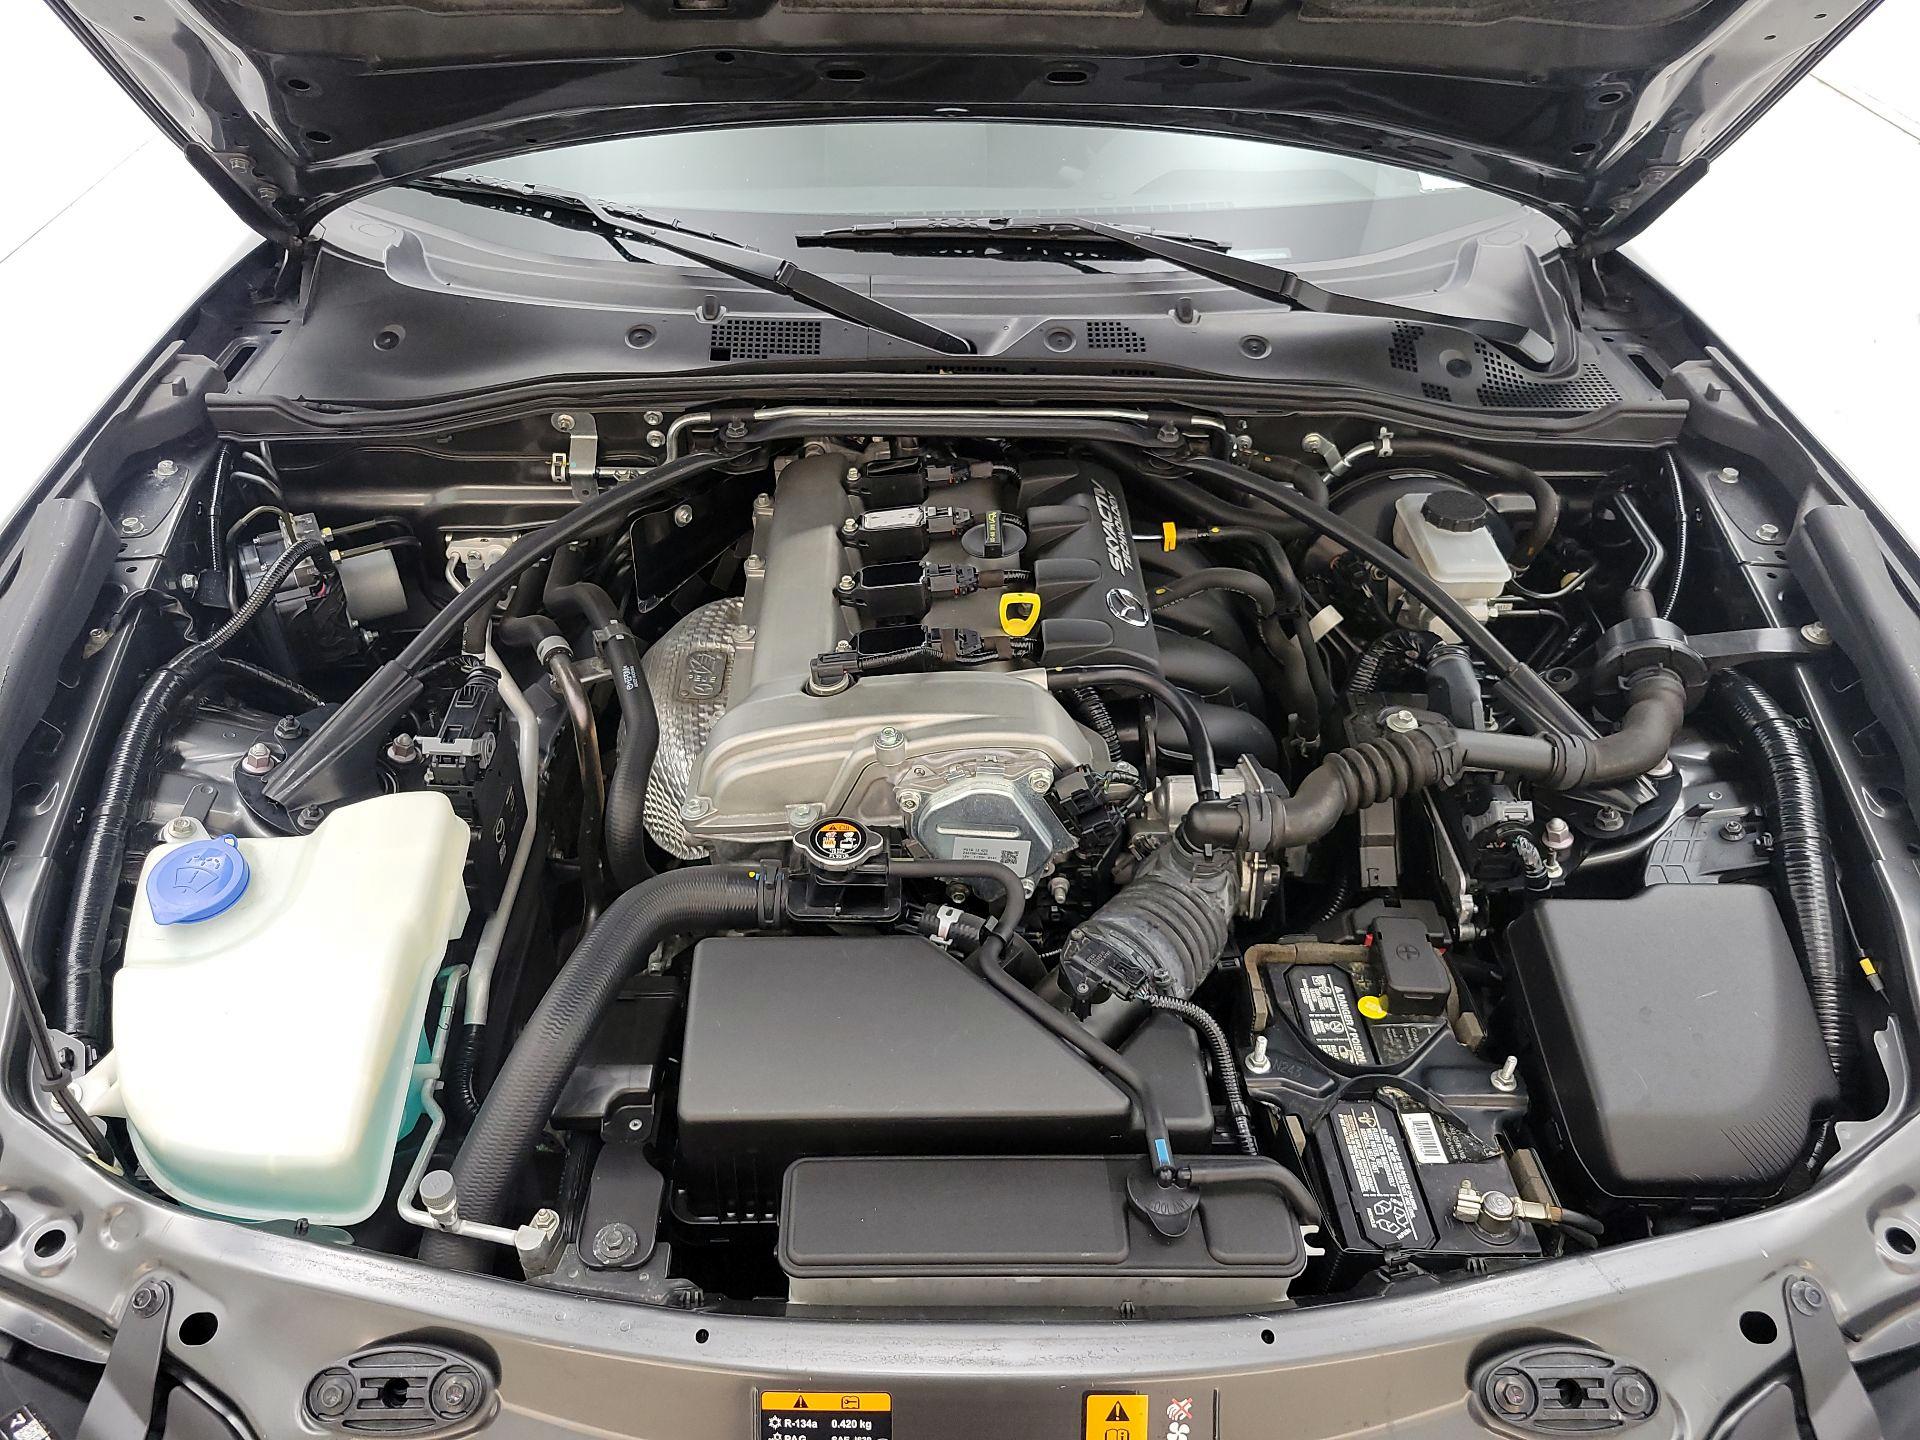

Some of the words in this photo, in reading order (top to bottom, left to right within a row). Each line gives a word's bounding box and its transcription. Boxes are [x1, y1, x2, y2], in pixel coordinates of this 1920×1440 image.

[1091, 478, 1126, 577] SKYACTIV
[1106, 489, 1134, 571] TECHNOLOGY
[784, 1418, 818, 1429] R-134a
[831, 1418, 857, 1429] 0.420
[859, 1418, 872, 1431] kg
